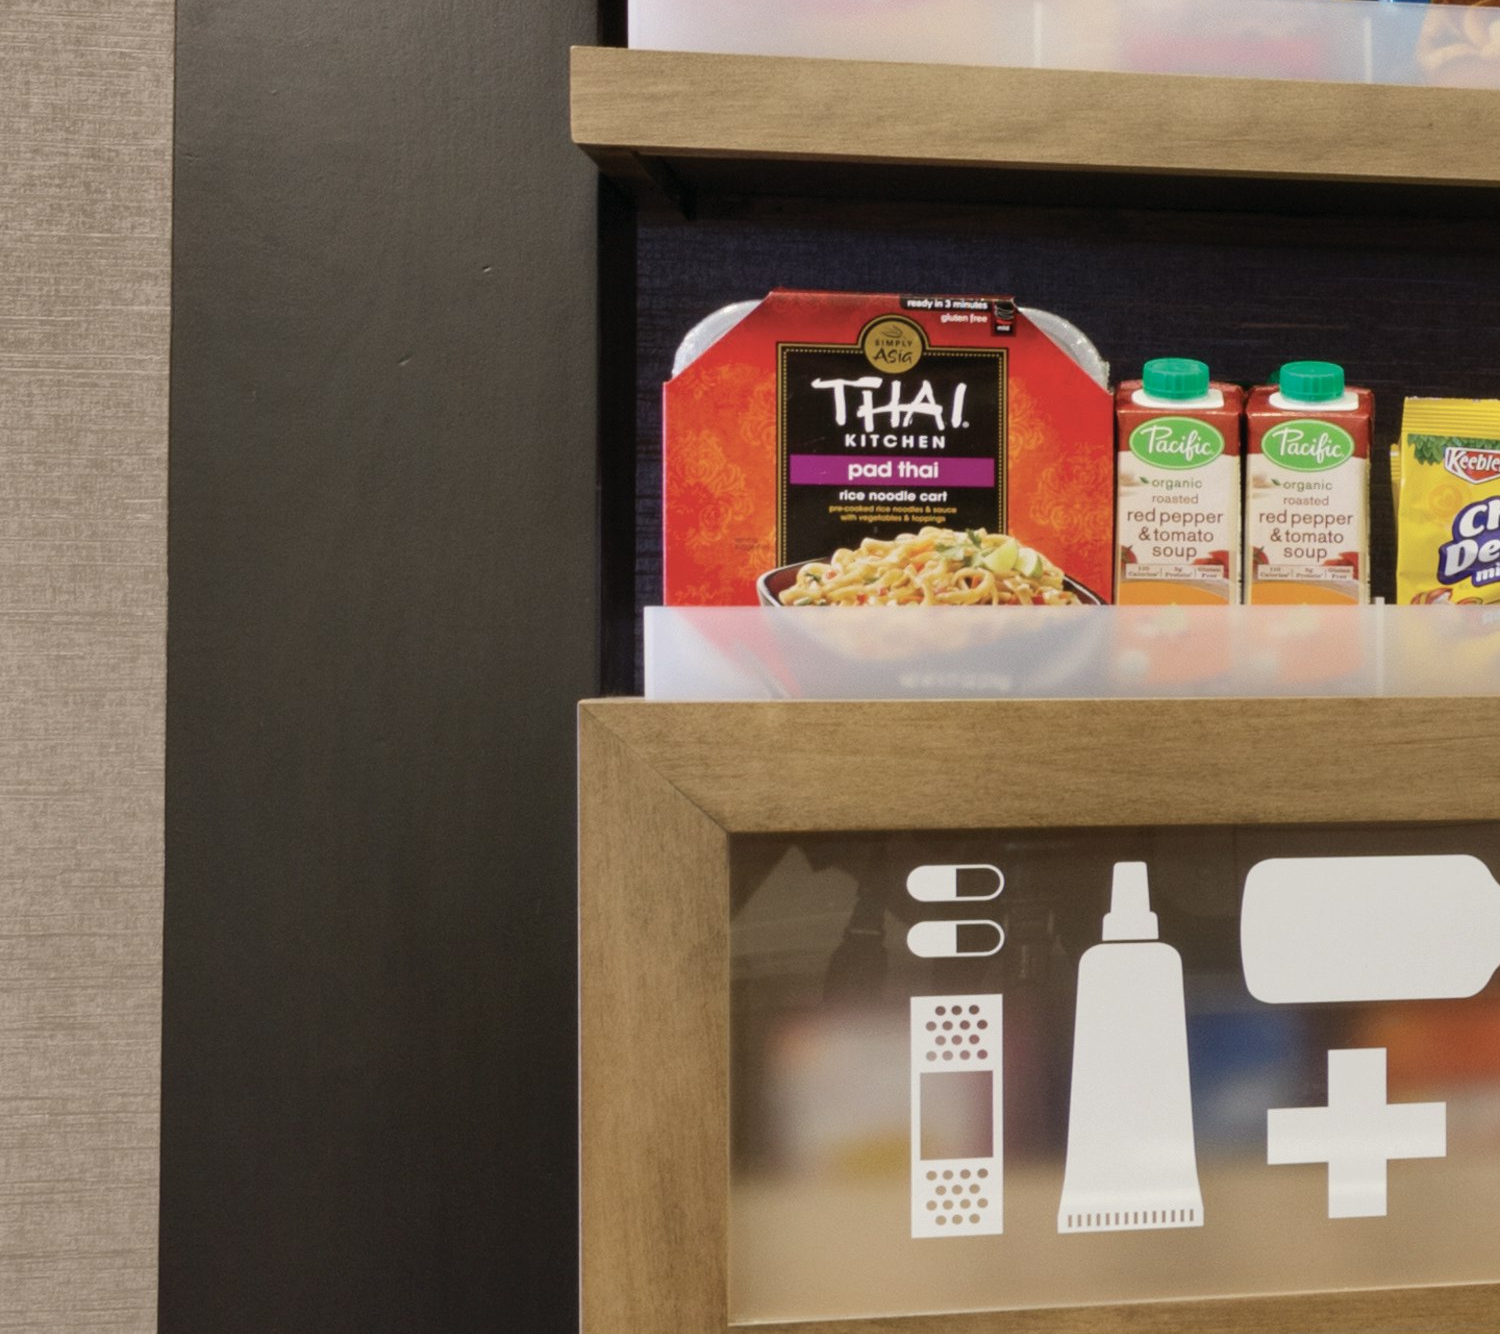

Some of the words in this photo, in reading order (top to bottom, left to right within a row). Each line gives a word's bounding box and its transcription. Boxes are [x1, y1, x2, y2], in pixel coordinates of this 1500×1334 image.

[812, 377, 967, 433] THAI
[845, 434, 945, 449] KITCHEN
[1140, 425, 1212, 461] Pacific
[1272, 427, 1343, 463] Pacific
[848, 461, 892, 480] pad
[899, 461, 938, 479] thai
[1152, 477, 1202, 490] organic
[1283, 479, 1333, 492] organic
[839, 490, 865, 501] rice
[869, 490, 915, 501] noodle
[920, 492, 947, 502] cart
[1152, 494, 1198, 504] roasted
[1283, 496, 1329, 506] roasted
[1128, 508, 1155, 523] red
[1160, 510, 1223, 526] pepper
[1259, 510, 1287, 524] red
[1292, 512, 1353, 528] pepper
[1138, 528, 1150, 540] &
[1153, 530, 1214, 542] tomato
[1270, 529, 1282, 542] &
[1286, 530, 1344, 543] tomato
[1152, 545, 1197, 560] soup
[1284, 546, 1327, 561] soup
